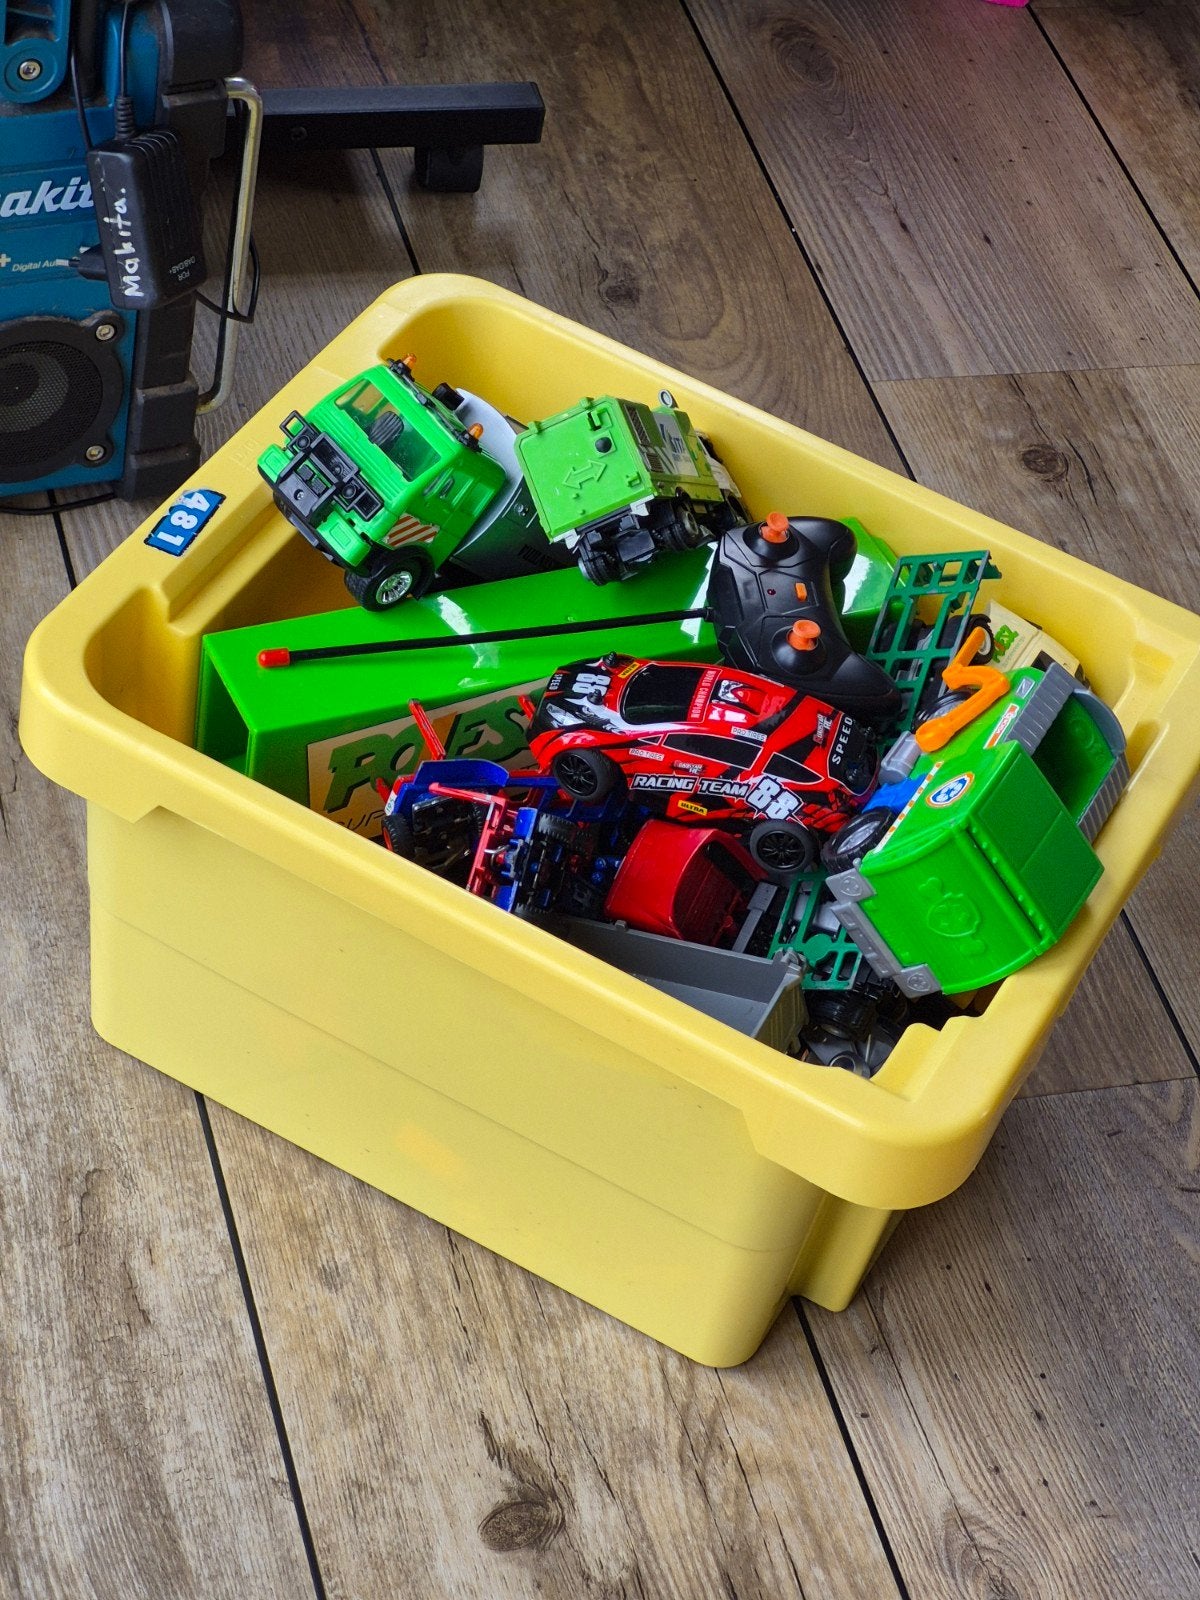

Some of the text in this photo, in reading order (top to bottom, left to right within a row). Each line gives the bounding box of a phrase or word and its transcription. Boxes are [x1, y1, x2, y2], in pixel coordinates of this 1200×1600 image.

[0, 177, 94, 217] akit
[12, 260, 41, 272] Digital
[690, 670, 717, 719] WORLD CHAMPION
[732, 727, 765, 741] PRO TIRES
[831, 716, 853, 765] SPEED
[633, 775, 749, 797] RACING TEAM
[747, 776, 799, 820] 88
[680, 801, 706, 814] ULTRA
